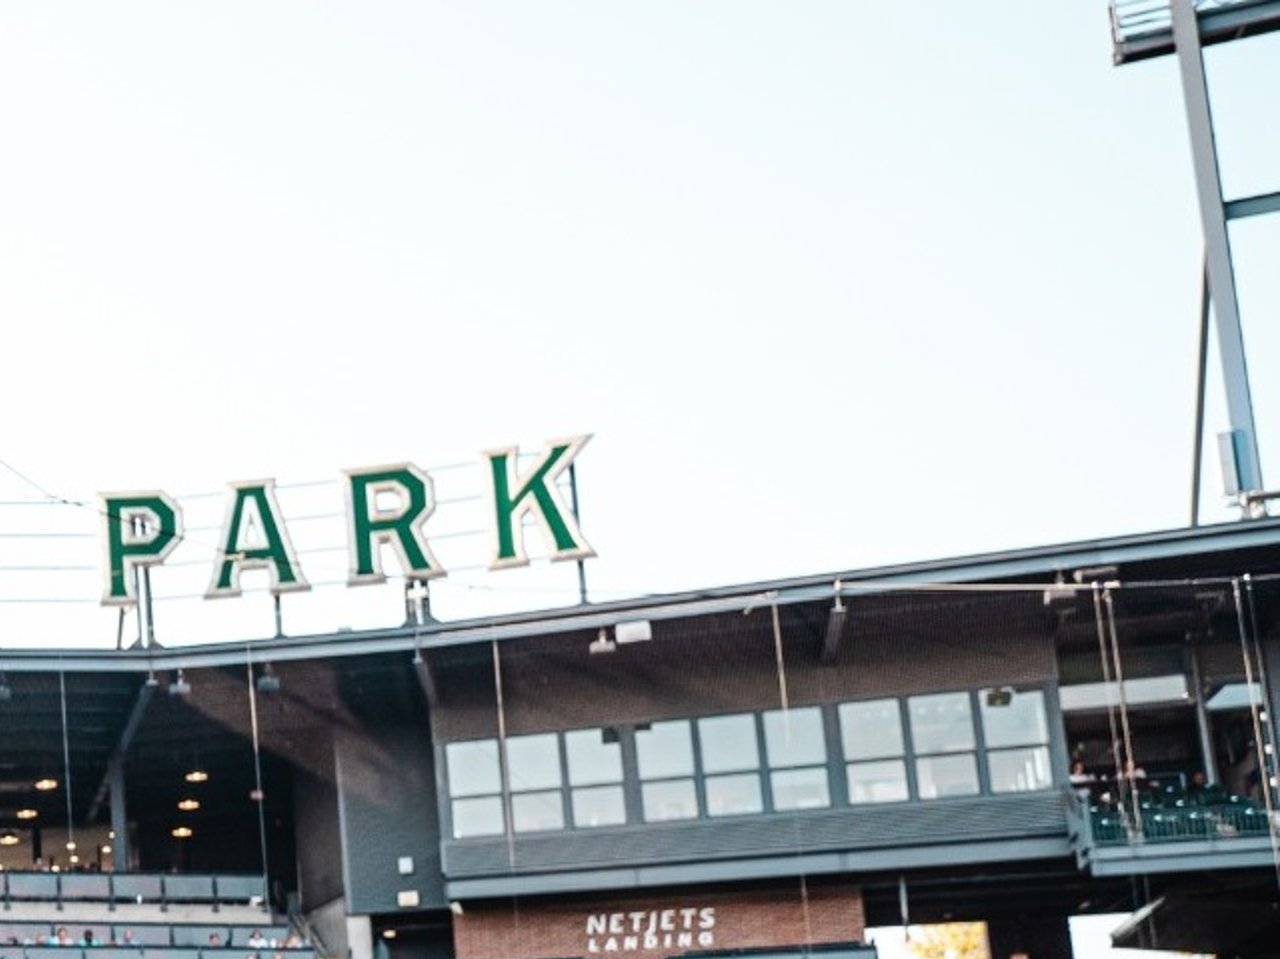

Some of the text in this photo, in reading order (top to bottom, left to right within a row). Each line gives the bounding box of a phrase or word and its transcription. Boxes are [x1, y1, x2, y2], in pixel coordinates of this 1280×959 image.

[97, 433, 597, 605] PARK
[586, 907, 715, 936] NETJETS
[589, 930, 714, 952] LANDING
